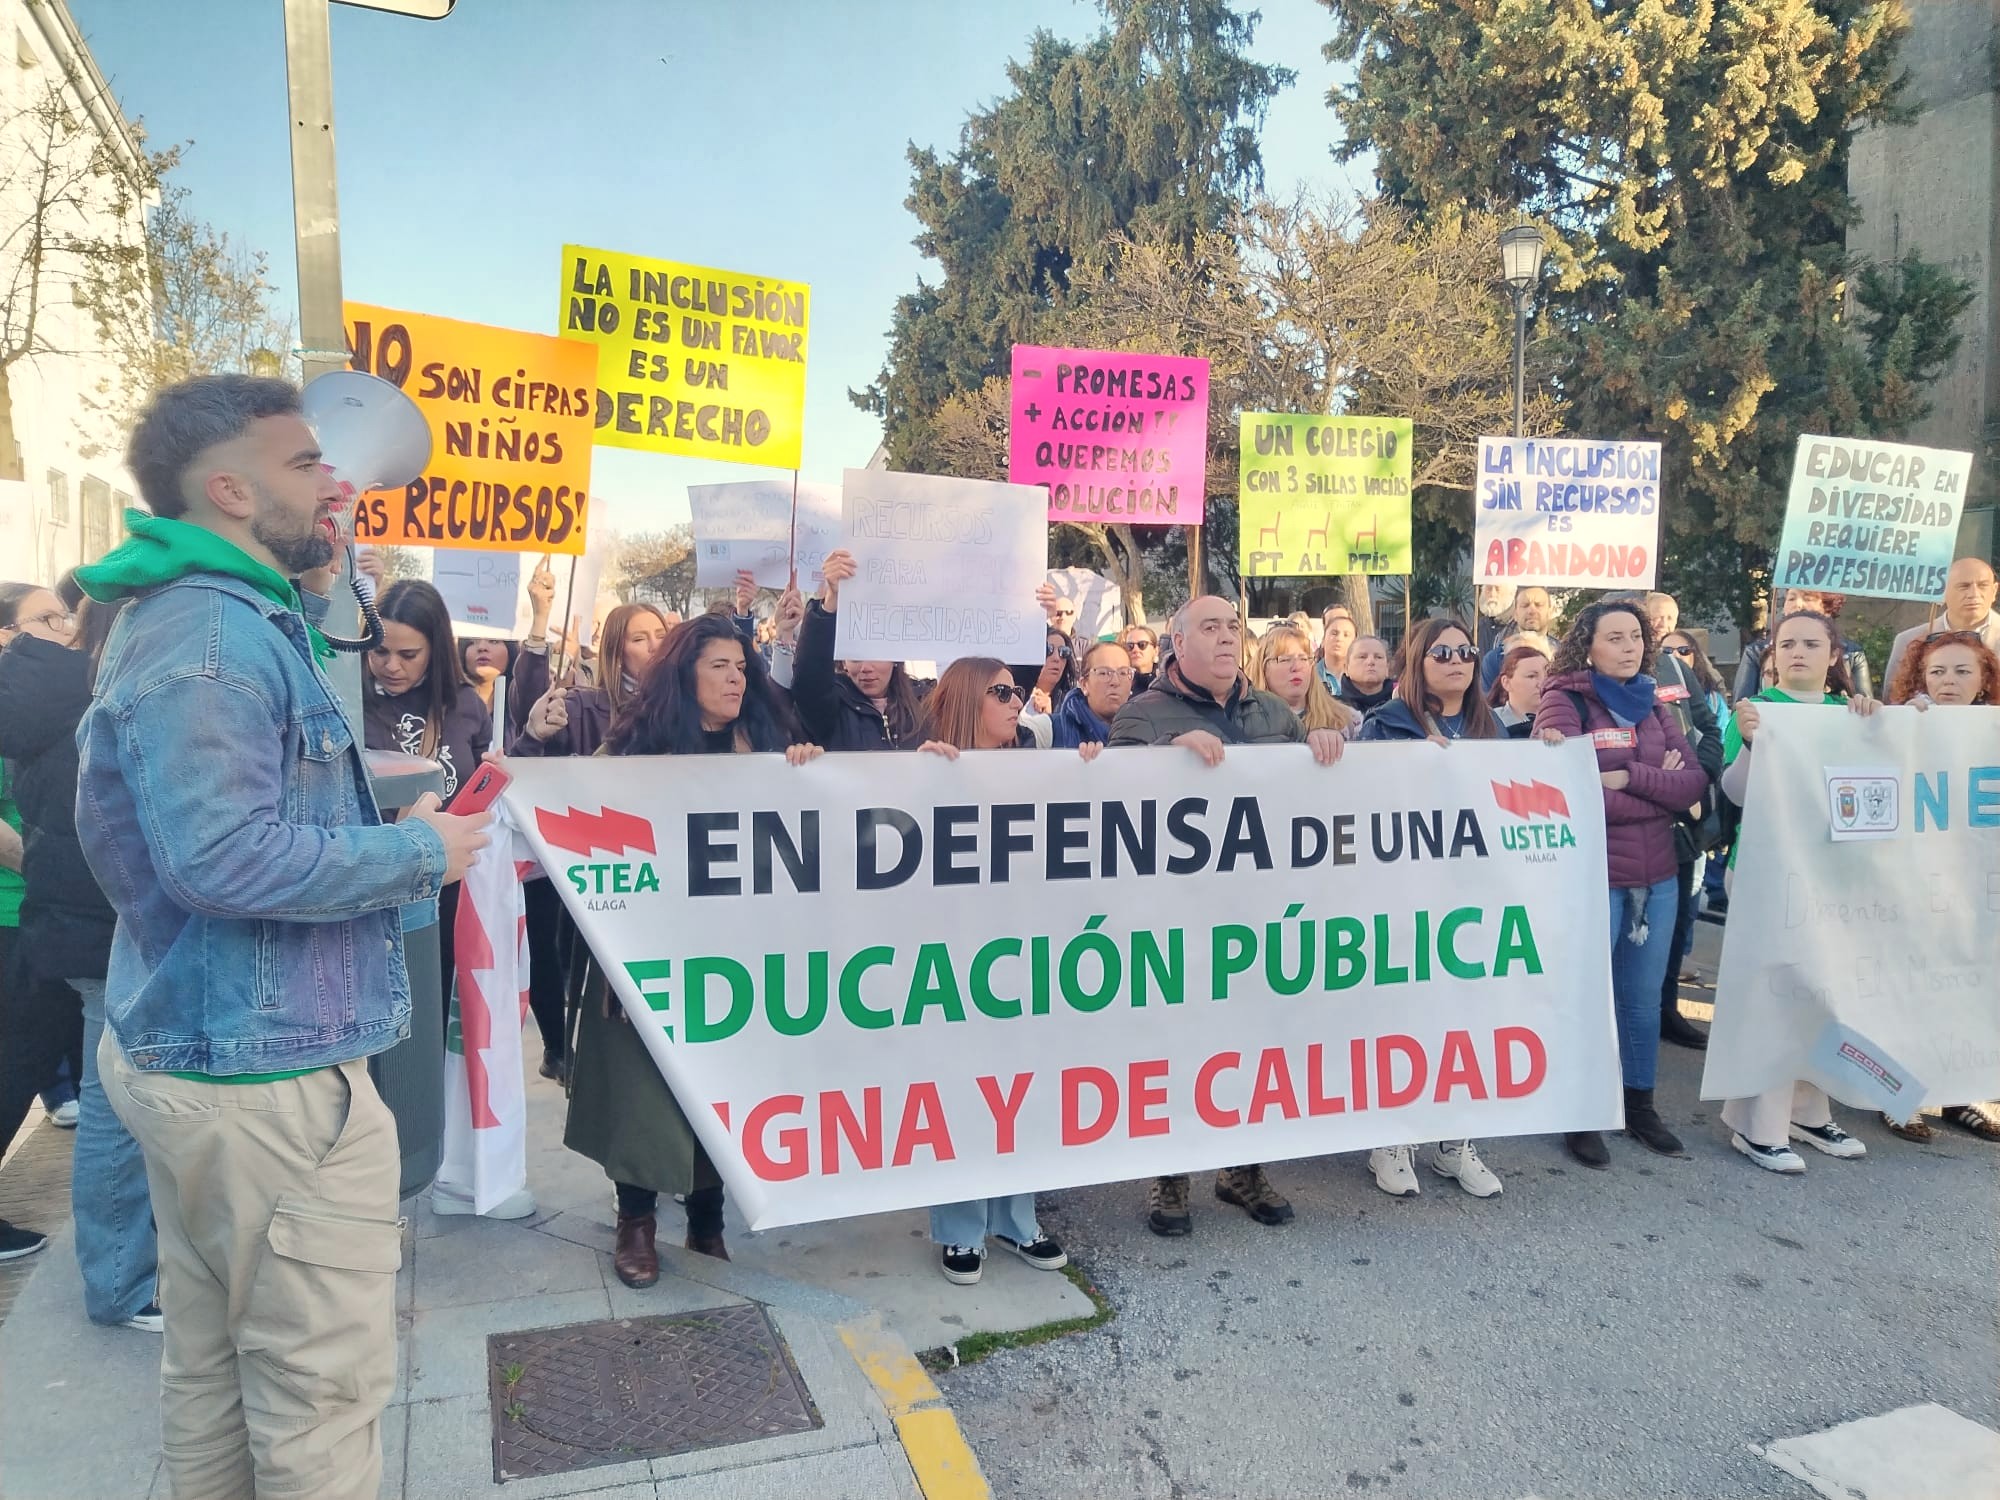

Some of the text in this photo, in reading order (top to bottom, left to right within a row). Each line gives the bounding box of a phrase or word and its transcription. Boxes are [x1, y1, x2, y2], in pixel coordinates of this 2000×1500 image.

[573, 257, 614, 298] LA
[567, 296, 805, 364] NO ES UN FAVOR
[344, 320, 413, 390] NO
[418, 362, 482, 404] SON
[628, 349, 729, 391] ES UN
[1056, 362, 1197, 402] PROMESAS
[1035, 441, 1173, 474] QUEREMOS
[1254, 424, 1294, 457] UN
[1485, 444, 1513, 474] LA
[1246, 469, 1281, 494] CON
[1287, 465, 1299, 493] 3
[1305, 473, 1357, 496] SILLAS
[1806, 443, 1960, 493] EDUCAR EN
[403, 475, 587, 545] RECURSOS!
[1535, 481, 1657, 516] RECURSOS
[852, 496, 993, 545] RECURSOS
[1547, 514, 1573, 532] ES
[867, 558, 928, 585] PARA
[1248, 550, 1284, 575] PT
[1298, 551, 1328, 572] AL
[1484, 537, 1648, 578] ABANDONO
[848, 601, 1021, 646] NECESIDADES
[686, 796, 1489, 898] EN DEFENSA DE UNA
[1500, 823, 1576, 851] USTEA
[1525, 851, 1557, 864] MÁLAGA
[566, 862, 659, 895] STEA
[587, 899, 626, 911] ÁLAGA
[1210, 903, 1544, 1002] PÚBLICA
[975, 1071, 1035, 1155] Y
[1060, 1058, 1171, 1147] DE
[1193, 1026, 1548, 1129] CALIDAD
